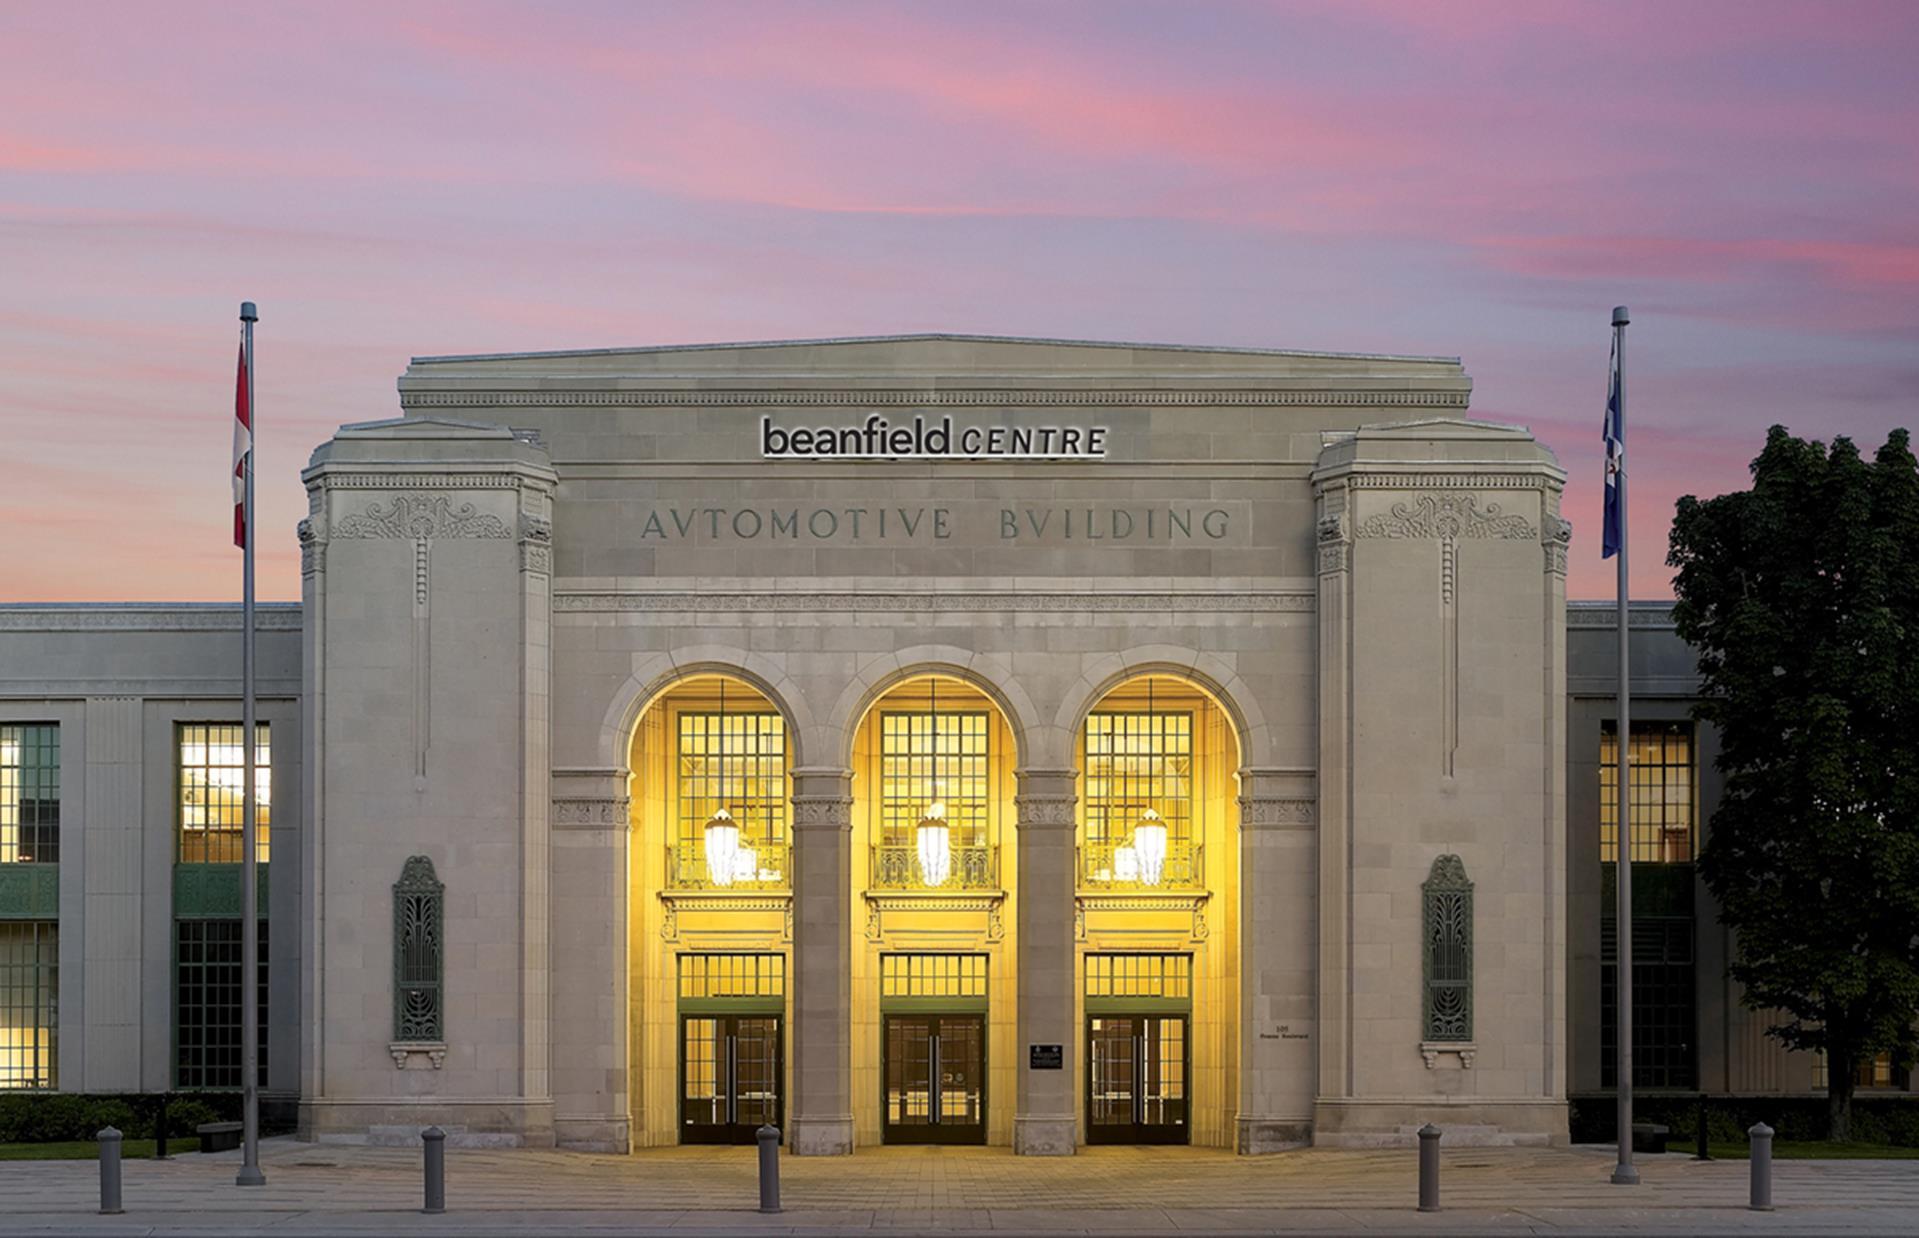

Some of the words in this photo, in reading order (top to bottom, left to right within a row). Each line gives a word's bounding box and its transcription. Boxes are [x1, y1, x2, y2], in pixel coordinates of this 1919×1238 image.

[763, 415, 950, 455] beanfield
[961, 428, 1107, 455] CENTRE
[641, 508, 951, 539] AVTOMOTIVE
[1000, 508, 1230, 539] BVILDING
